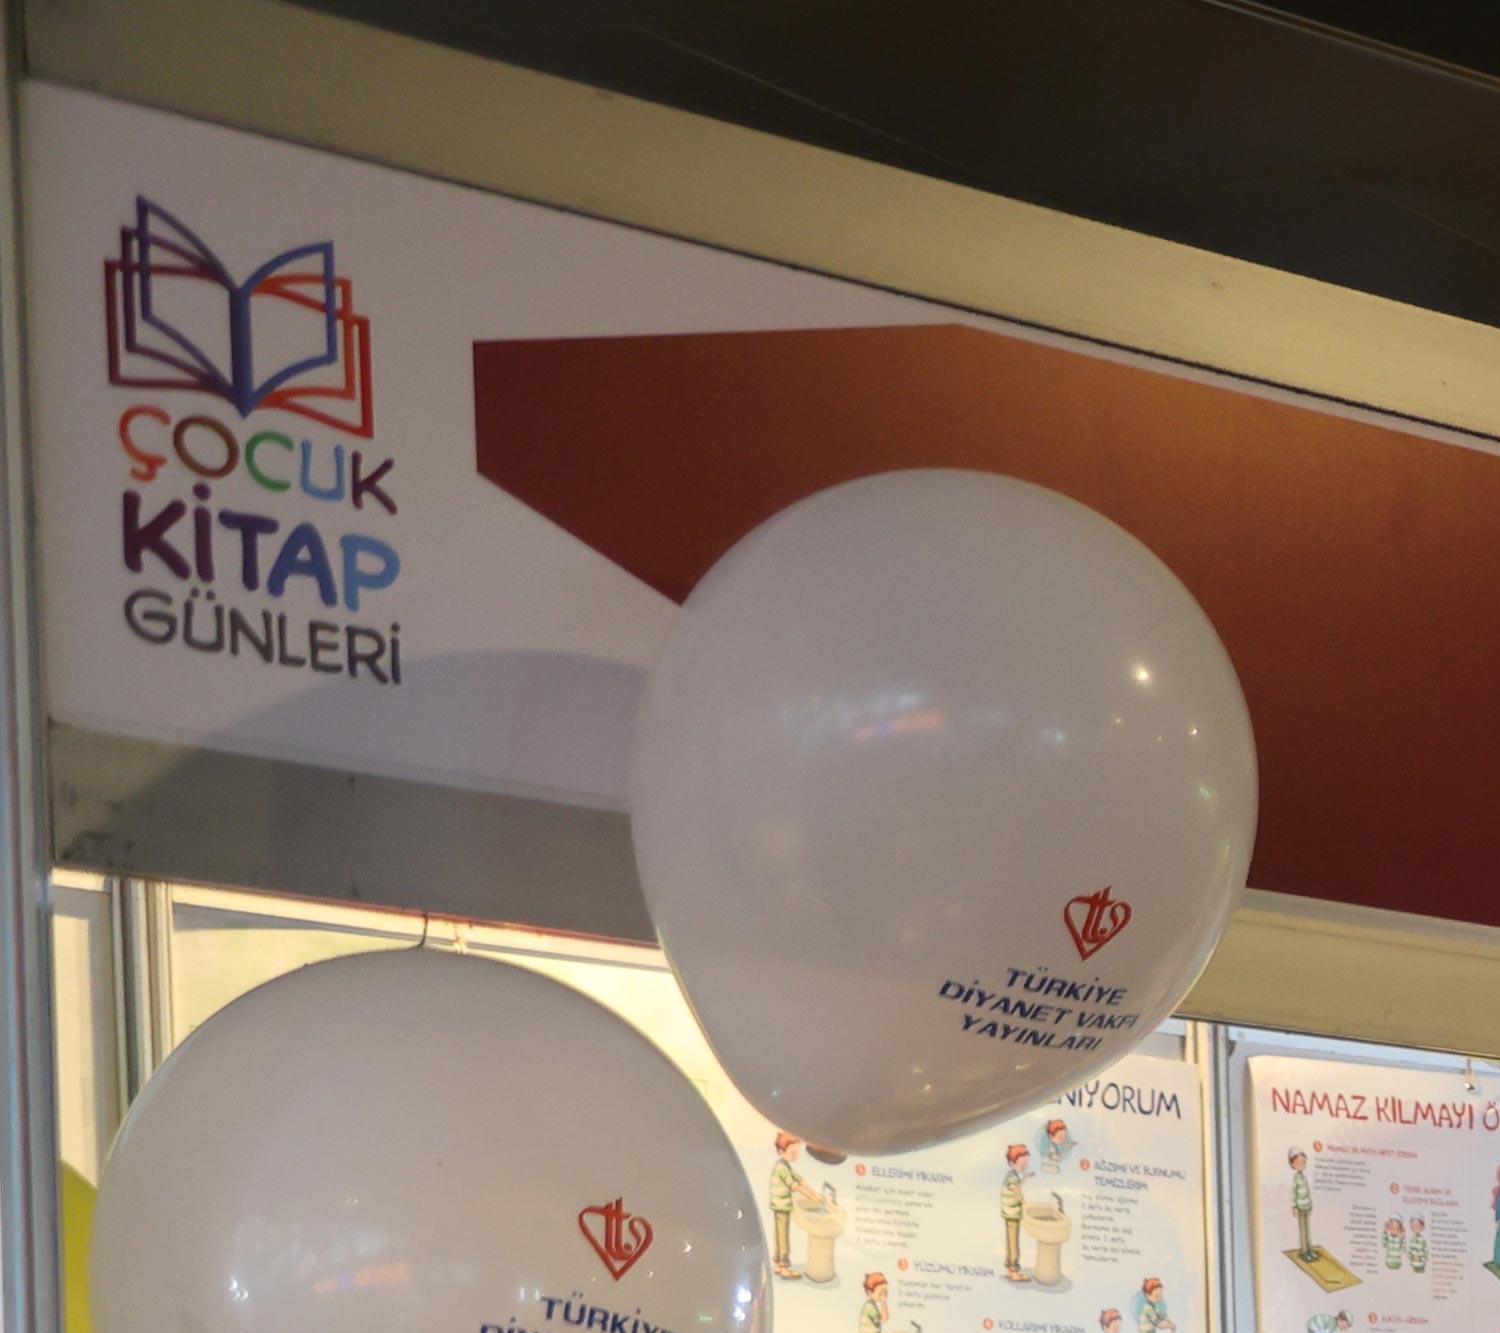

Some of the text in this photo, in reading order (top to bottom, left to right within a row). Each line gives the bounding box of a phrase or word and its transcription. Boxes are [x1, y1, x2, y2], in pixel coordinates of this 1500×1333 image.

[117, 405, 398, 516] ÇOCUK
[121, 485, 400, 611] KİTAP
[123, 588, 402, 686] GÜNLERİ
[939, 980, 1141, 1030] DİYANET VAKFI
[1006, 965, 1128, 1007] TÜRKİYE
[961, 1014, 1103, 1051] YAYINLARI
[1271, 1086, 1369, 1121] NAMAZ
[1376, 1096, 1475, 1131] KILMAYI
